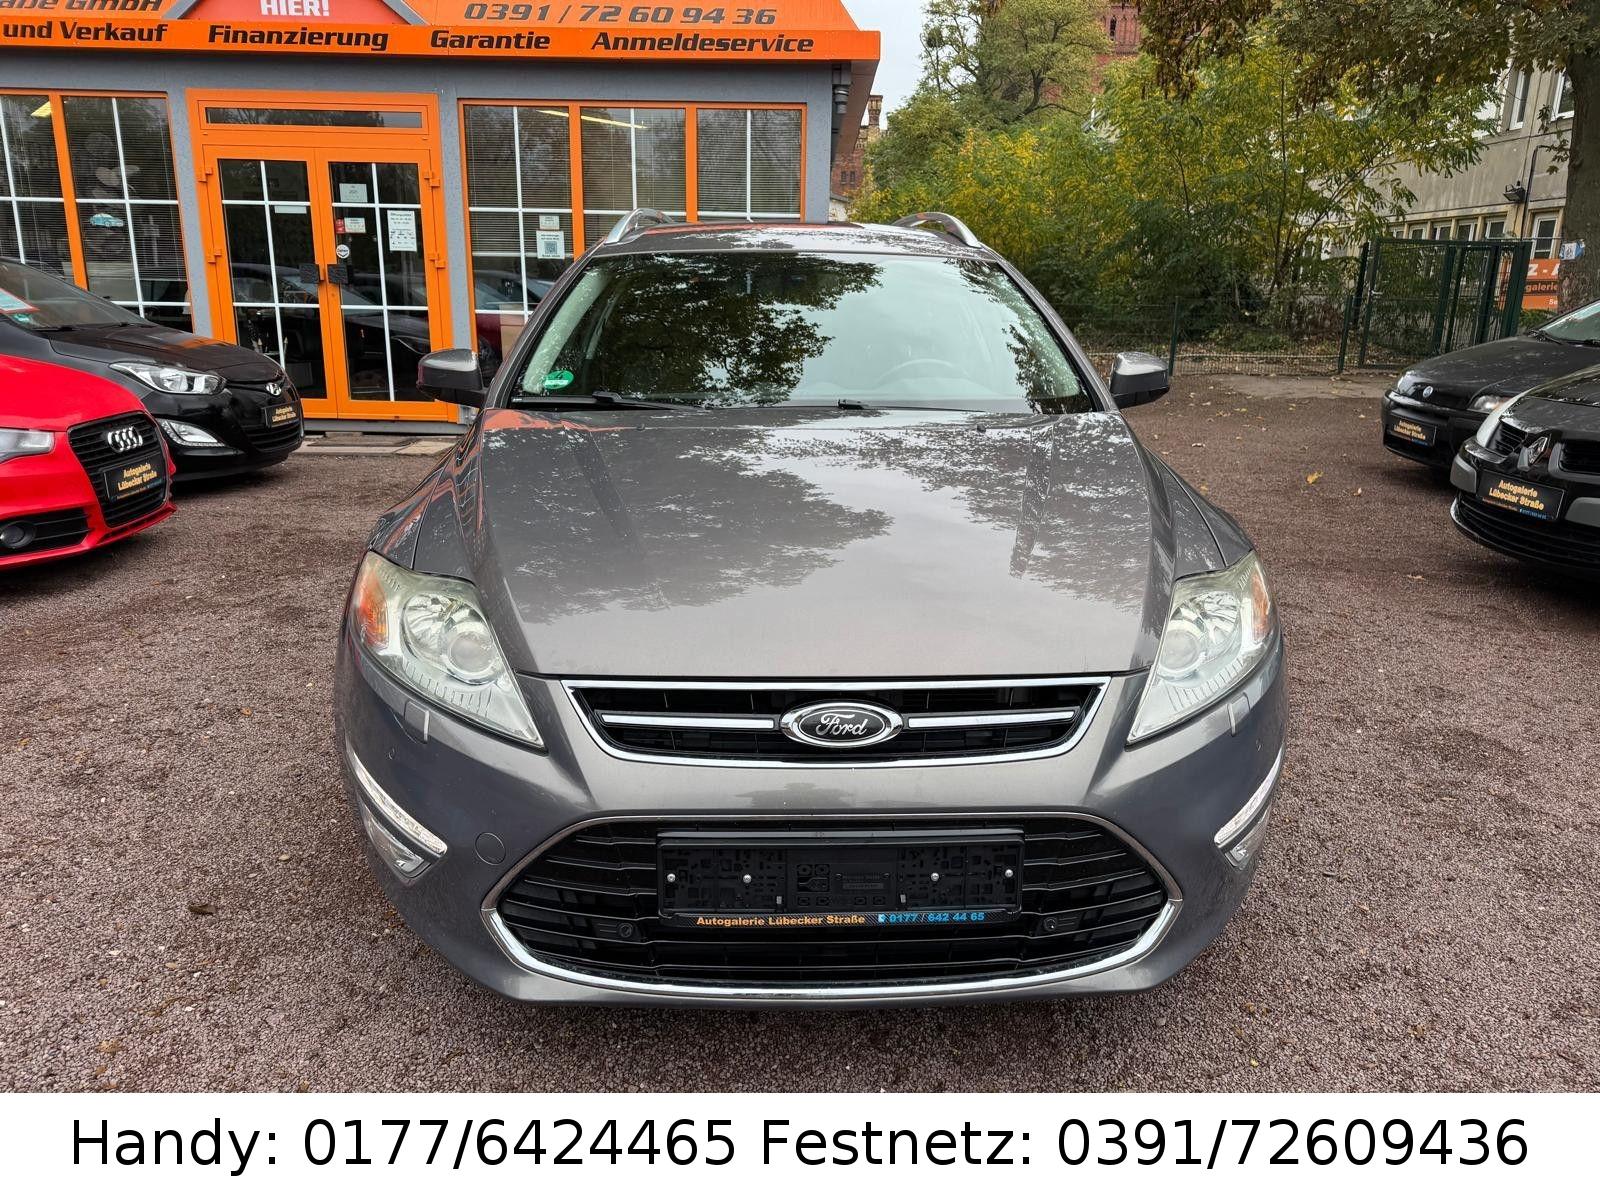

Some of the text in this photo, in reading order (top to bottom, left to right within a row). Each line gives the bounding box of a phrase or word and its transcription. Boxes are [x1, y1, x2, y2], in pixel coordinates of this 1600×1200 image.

[260, 0, 330, 16] HIER!
[464, 3, 778, 25] 0391 / 72 60 94 36
[3, 21, 169, 42] und Verkauf
[208, 24, 389, 51] Finanzierung
[431, 30, 551, 50] Garantie
[591, 32, 815, 52] Anmeldeservice
[1498, 480, 1538, 497] Autogalerie
[815, 713, 868, 736] Ford
[696, 917, 765, 927] Autogalerie
[768, 915, 823, 925] Lübecker
[826, 914, 865, 924] Straße
[889, 913, 919, 922] 0177
[927, 912, 950, 921] 642
[953, 912, 968, 921] 44
[971, 911, 985, 921] 65
